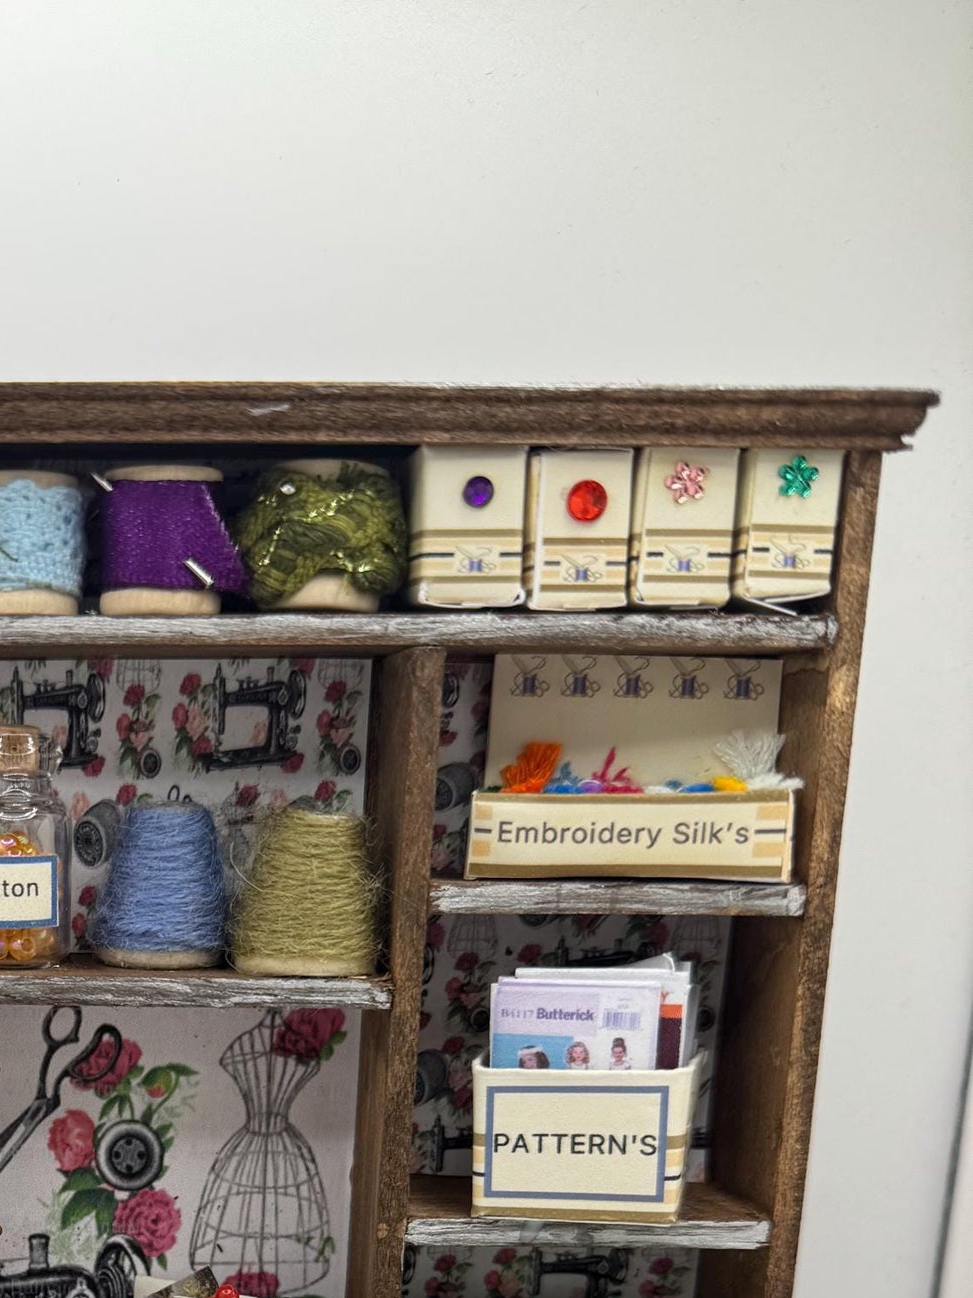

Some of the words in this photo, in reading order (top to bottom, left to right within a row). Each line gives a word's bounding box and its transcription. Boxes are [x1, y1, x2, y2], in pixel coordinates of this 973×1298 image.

[497, 820, 663, 850] Embroidery
[672, 821, 749, 845] Silk's
[536, 1007, 595, 1022] Butterick
[493, 1132, 658, 1157] PATTERN'S
